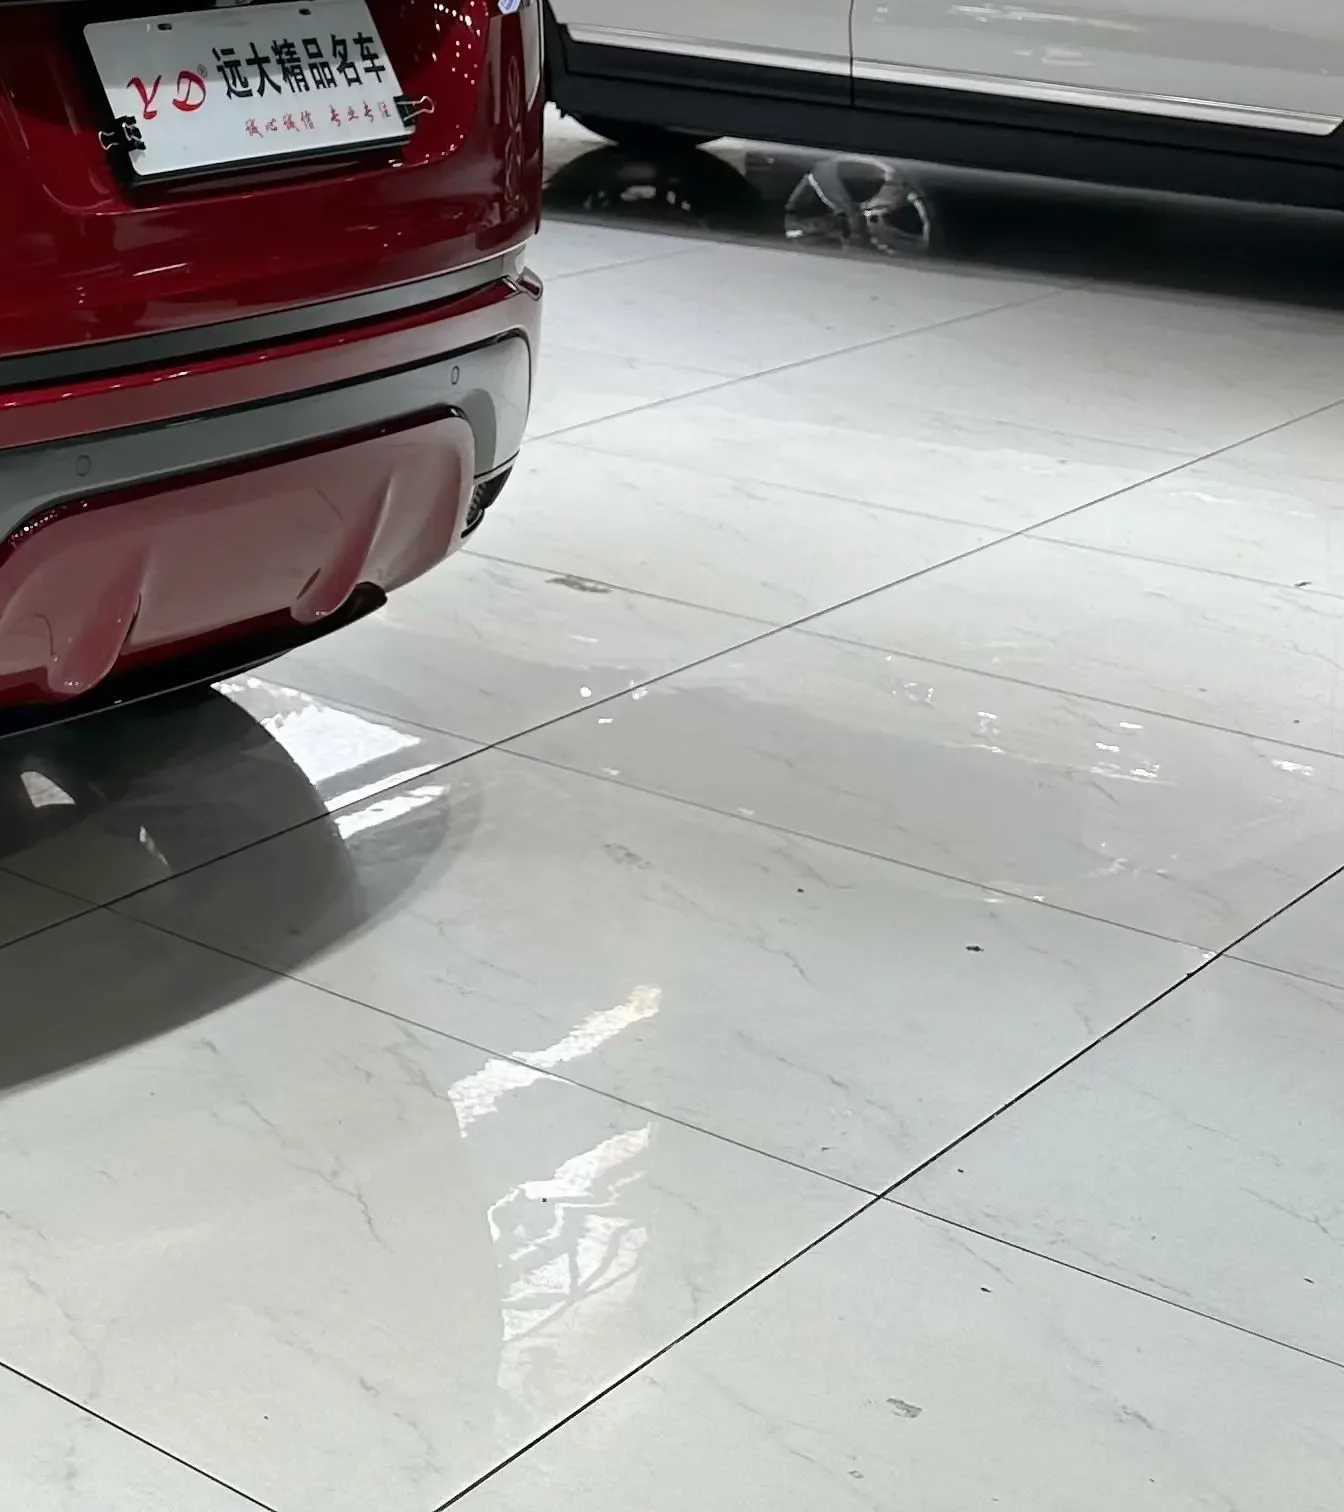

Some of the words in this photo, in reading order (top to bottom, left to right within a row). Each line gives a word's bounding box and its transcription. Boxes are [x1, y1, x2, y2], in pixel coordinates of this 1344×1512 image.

[212, 32, 386, 99] 远大精品名车
